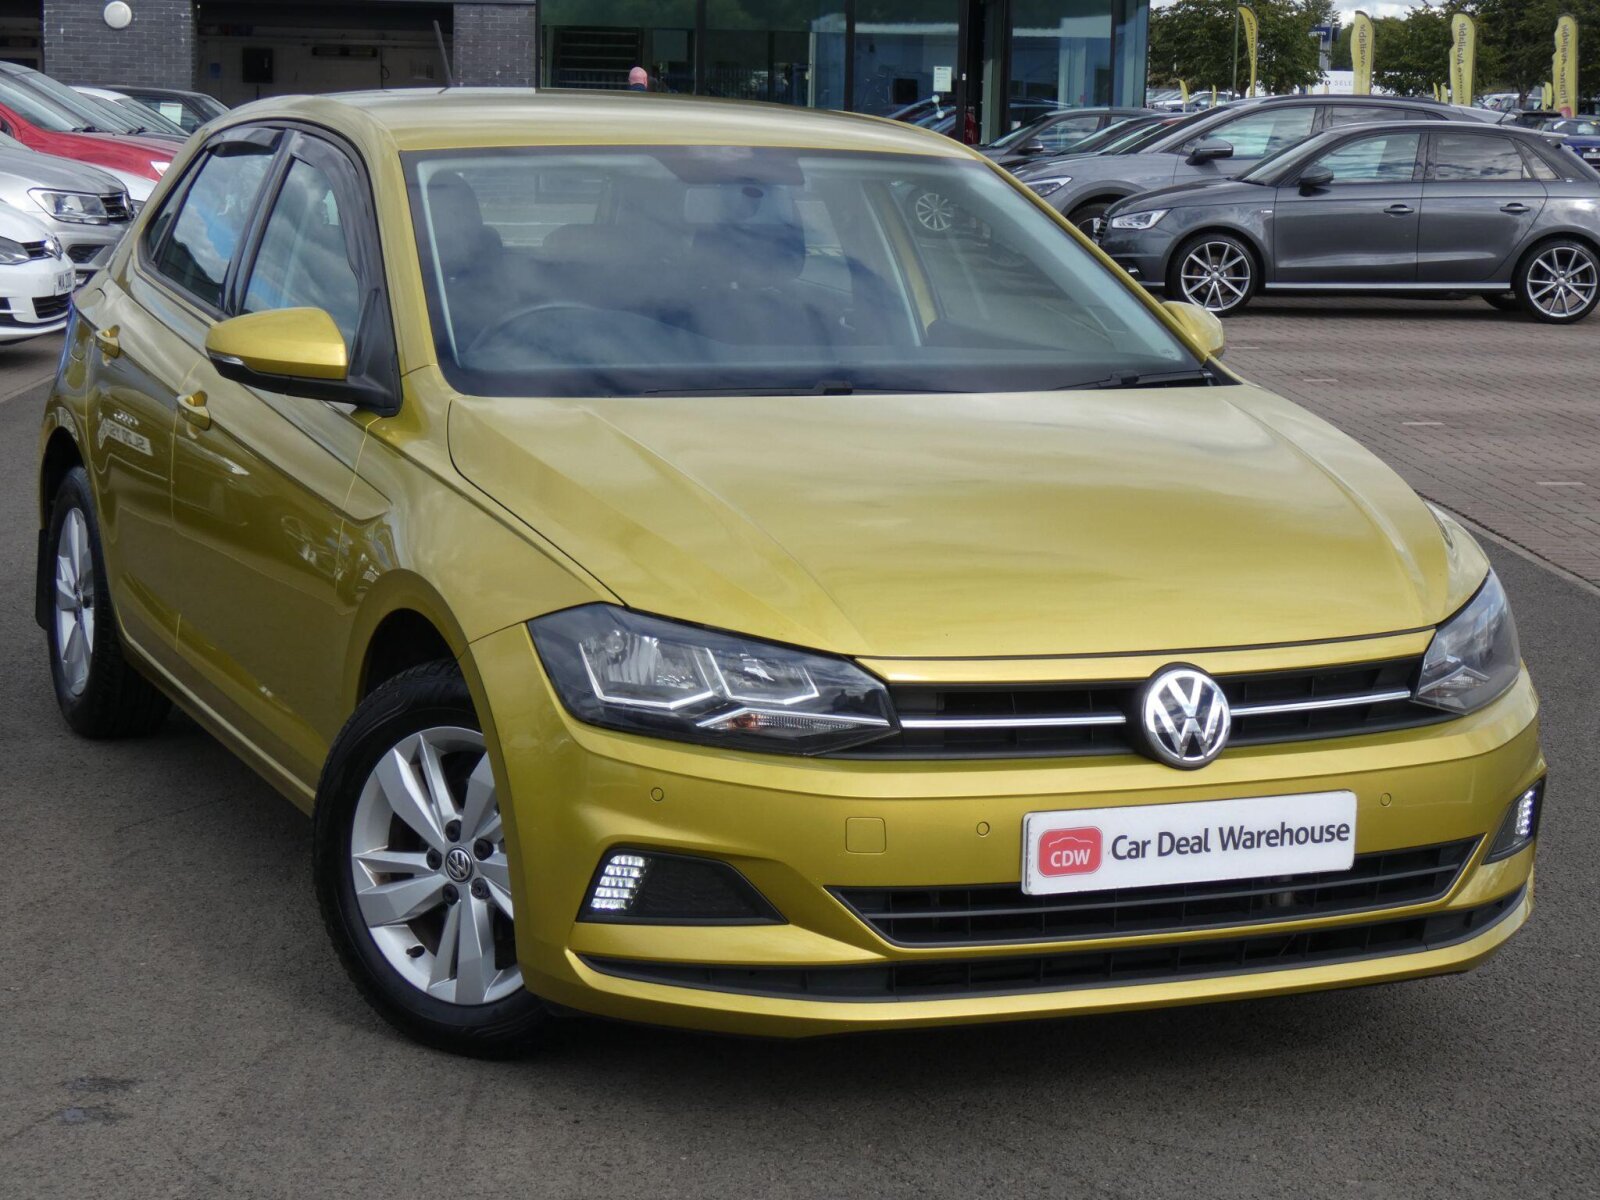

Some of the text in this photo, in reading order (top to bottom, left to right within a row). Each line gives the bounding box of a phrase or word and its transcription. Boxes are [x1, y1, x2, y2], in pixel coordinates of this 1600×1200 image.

[1111, 821, 1350, 861] Car Deal Warehouse
[1050, 848, 1091, 868] CDW
